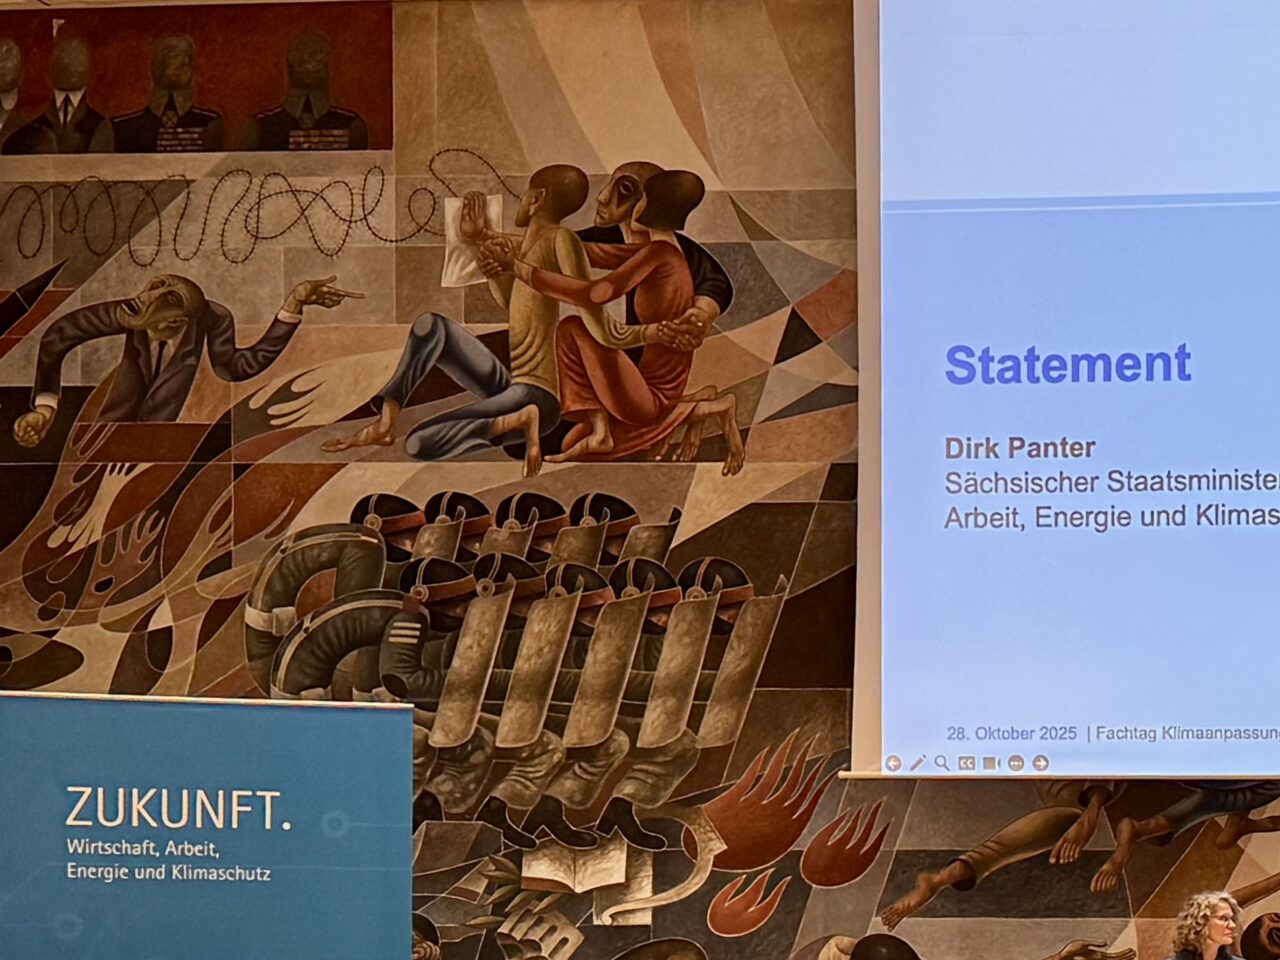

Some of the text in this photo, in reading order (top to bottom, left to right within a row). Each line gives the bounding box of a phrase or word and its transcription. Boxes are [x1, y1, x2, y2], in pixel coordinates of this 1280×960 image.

[945, 342, 1192, 385] Statement
[945, 436, 1096, 459] Dirk Panter
[945, 471, 1099, 494] Sächsischer
[944, 506, 1025, 532] Arbeit,
[1035, 505, 1132, 534] Energie
[1141, 504, 1186, 527] und
[947, 727, 970, 741] 28.
[975, 726, 1036, 741] Oktober
[1039, 726, 1077, 741] 2025
[1096, 725, 1157, 743] Fachtag
[66, 786, 291, 831] ZUKUNFT.
[66, 838, 219, 859] Wirtschaft, Arbeit,
[67, 862, 271, 882] Energie und Klimaschutz
